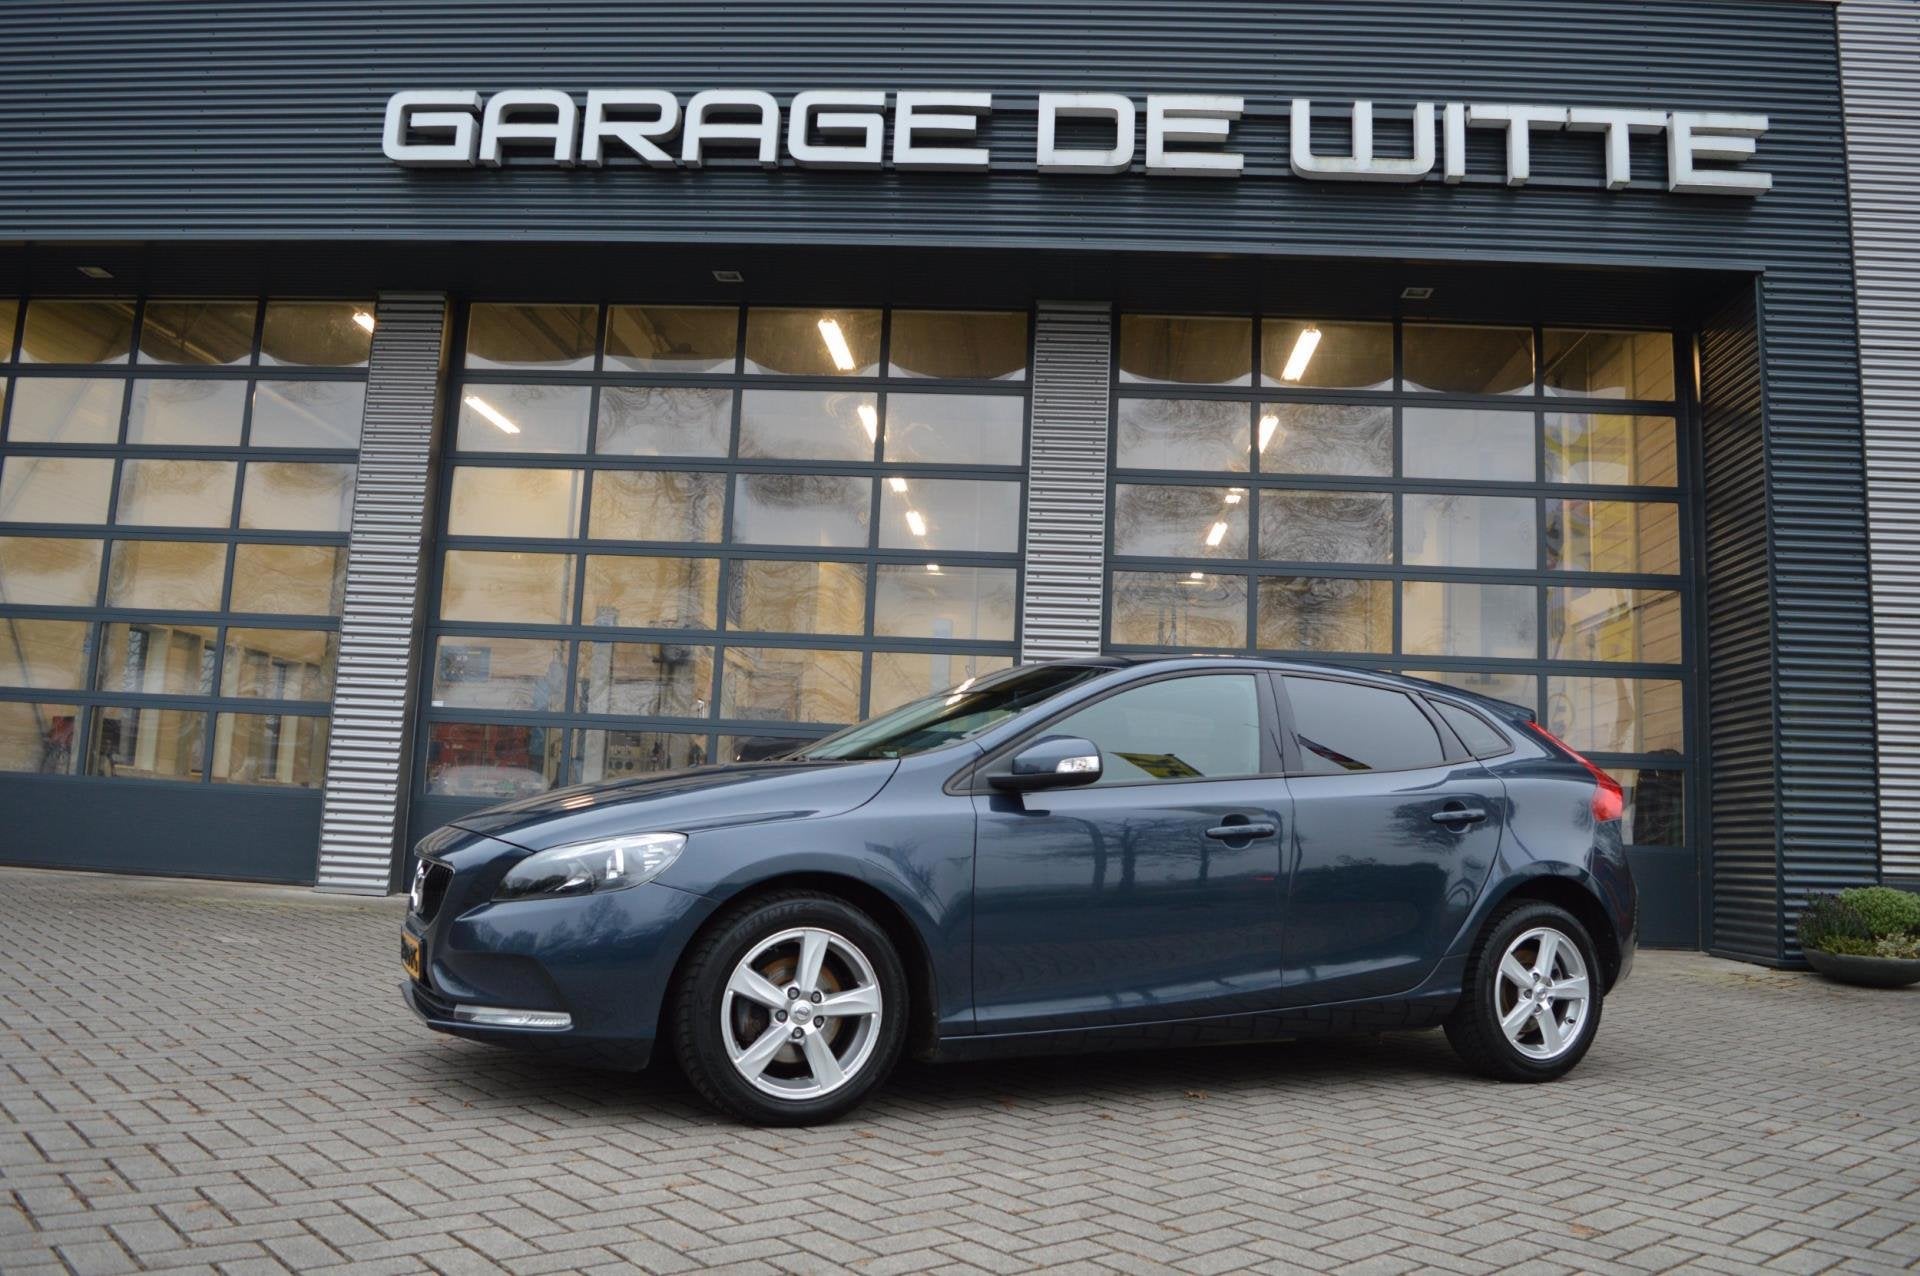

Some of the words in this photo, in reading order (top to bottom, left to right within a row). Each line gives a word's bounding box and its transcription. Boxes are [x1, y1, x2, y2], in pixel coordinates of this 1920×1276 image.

[382, 89, 992, 168] GARAGE
[1036, 92, 1244, 177] DE
[1289, 98, 1773, 196] WITTE
